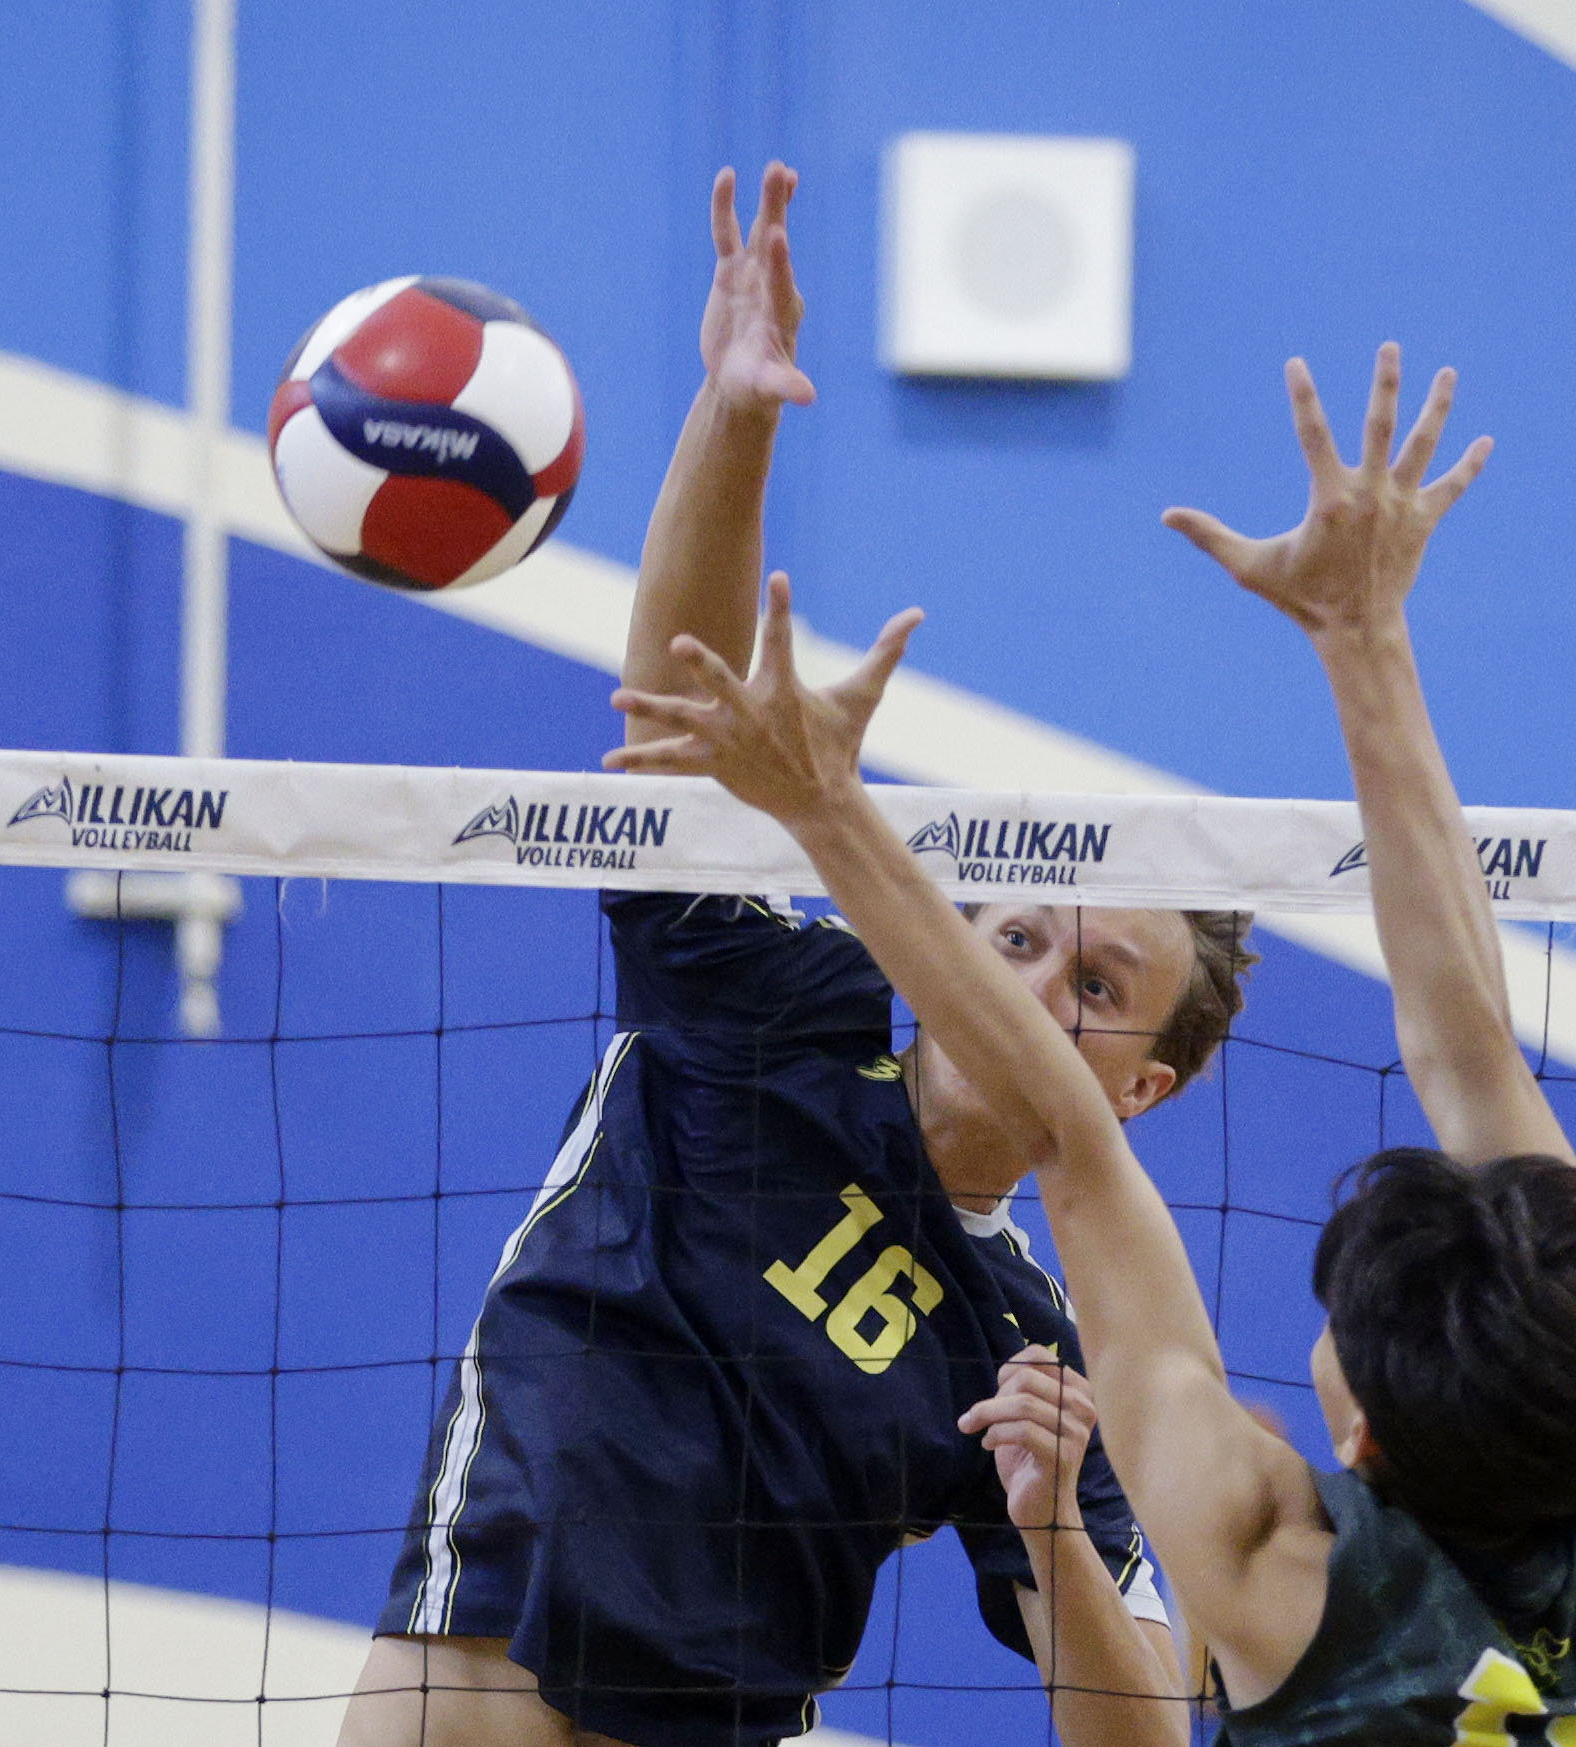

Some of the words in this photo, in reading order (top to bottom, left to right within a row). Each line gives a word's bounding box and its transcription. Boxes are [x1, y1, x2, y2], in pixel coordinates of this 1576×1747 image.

[71, 829, 193, 853] VOLLEYBALL
[517, 846, 637, 871] VOLLEYBALL
[959, 862, 1078, 886] VOLLEYBALL
[763, 1183, 944, 1374] 16
